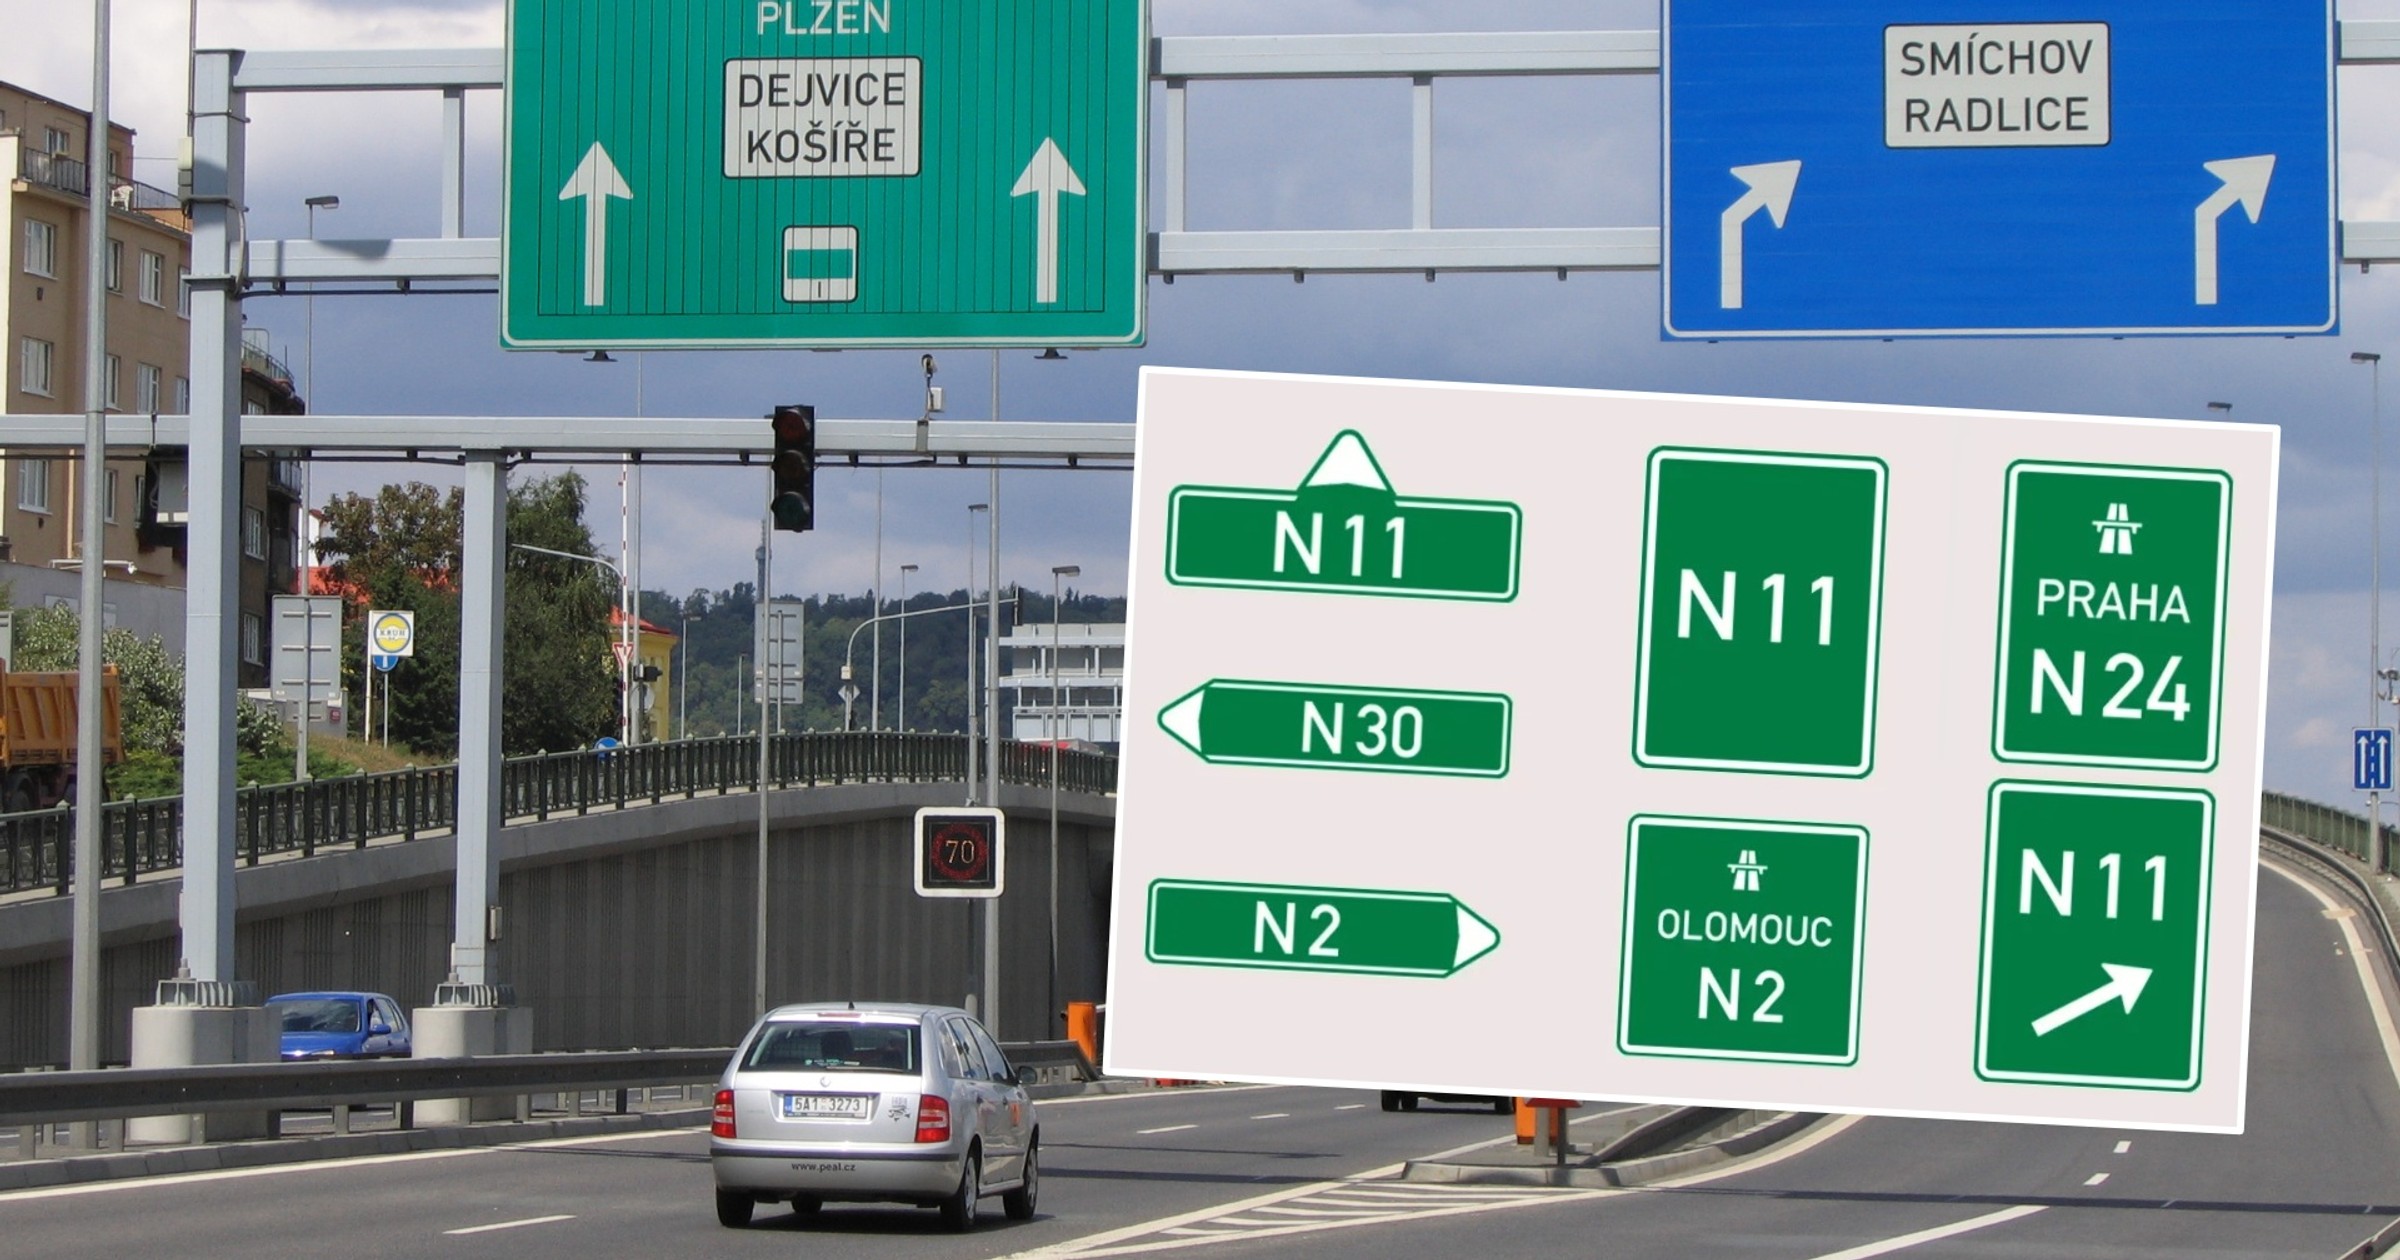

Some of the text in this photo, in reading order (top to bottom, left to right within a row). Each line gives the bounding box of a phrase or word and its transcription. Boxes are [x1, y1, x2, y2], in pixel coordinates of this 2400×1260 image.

[1900, 32, 2093, 76] SMÍCHOV
[738, 72, 906, 108] DEJVICE
[1905, 96, 2089, 133] RADLICE
[747, 120, 896, 164] KOŠÍŘE
[945, 840, 975, 864] 70
[791, 1162, 857, 1174] www.peal.cz
